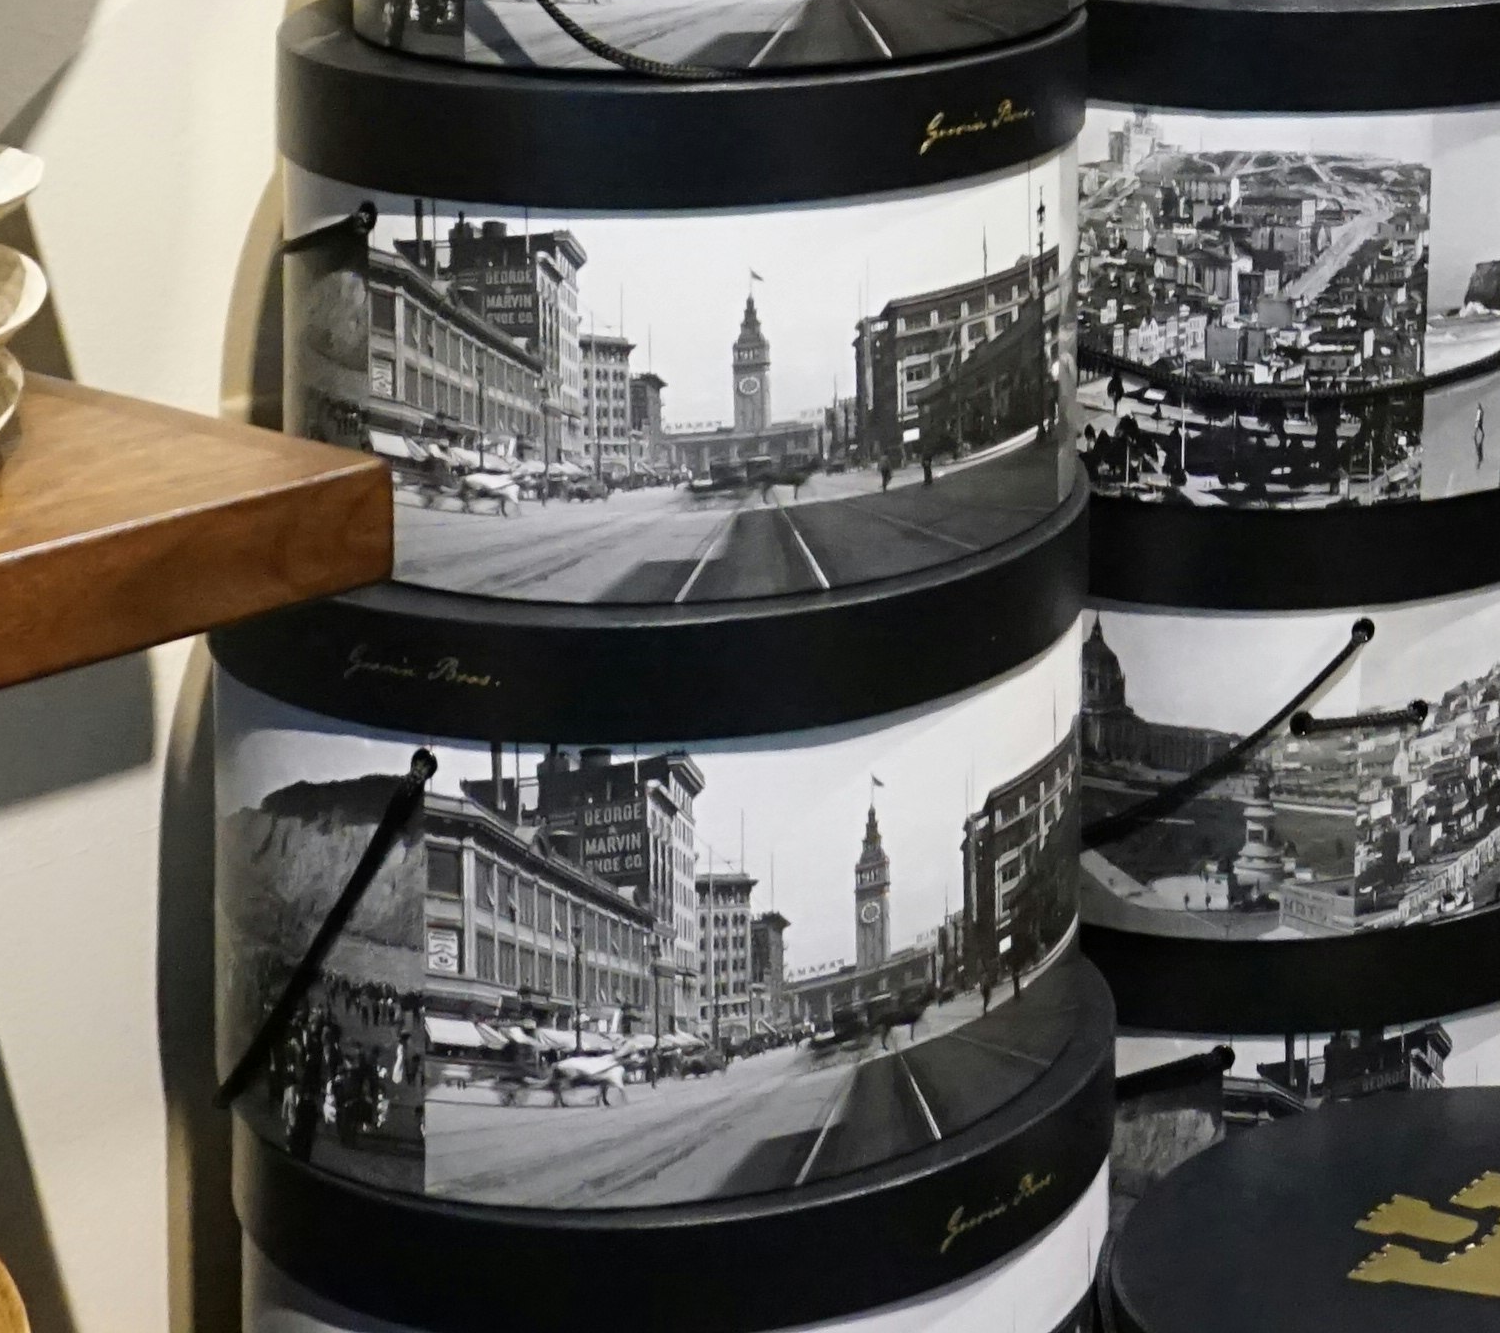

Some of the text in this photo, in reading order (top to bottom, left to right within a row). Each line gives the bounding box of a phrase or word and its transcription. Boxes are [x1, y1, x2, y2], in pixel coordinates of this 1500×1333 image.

[486, 293, 533, 309] MARVIN
[584, 802, 643, 827] GEORGE
[584, 832, 643, 856] MARVIN
